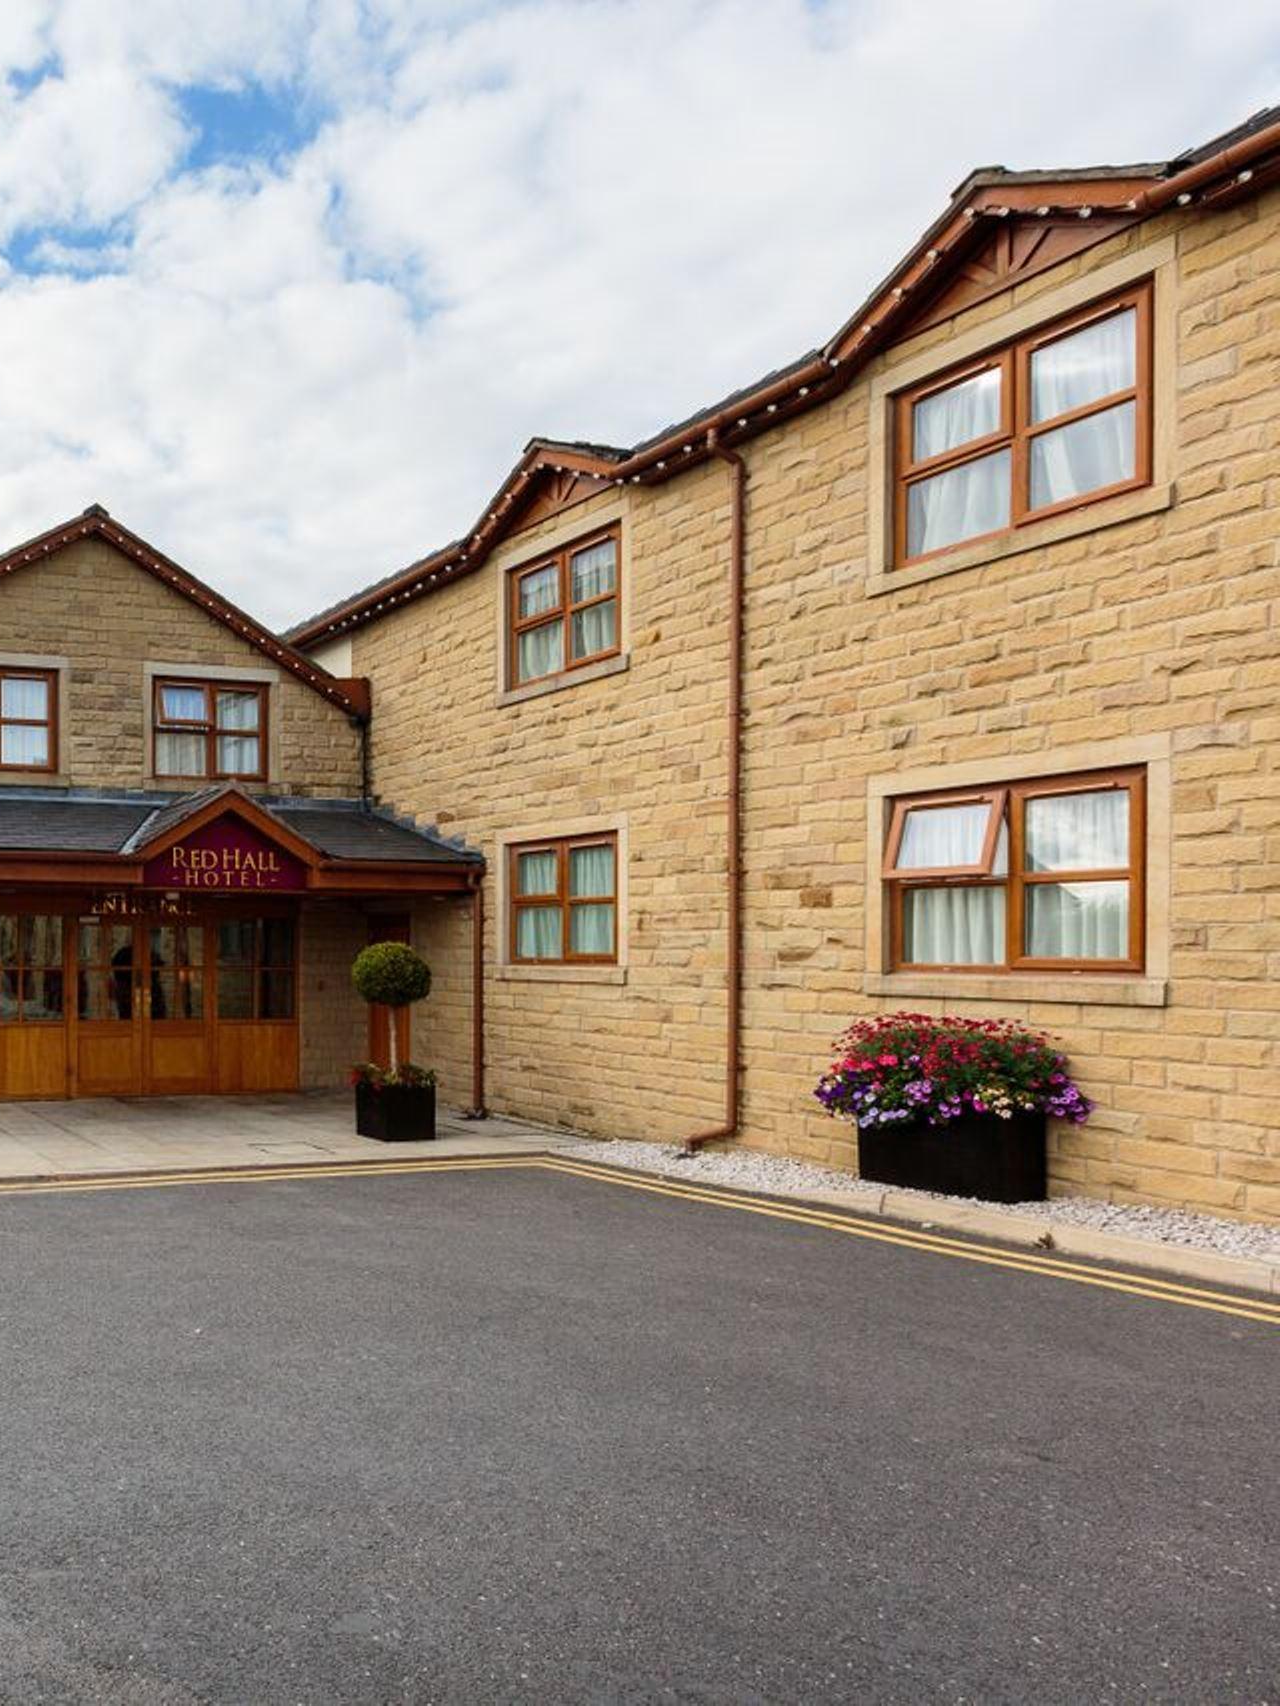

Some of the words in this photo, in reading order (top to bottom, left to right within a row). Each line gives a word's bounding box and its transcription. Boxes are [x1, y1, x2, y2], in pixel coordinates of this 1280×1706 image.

[173, 847, 218, 870] RED
[222, 848, 280, 871] HALL
[185, 870, 265, 887] HOTEL
